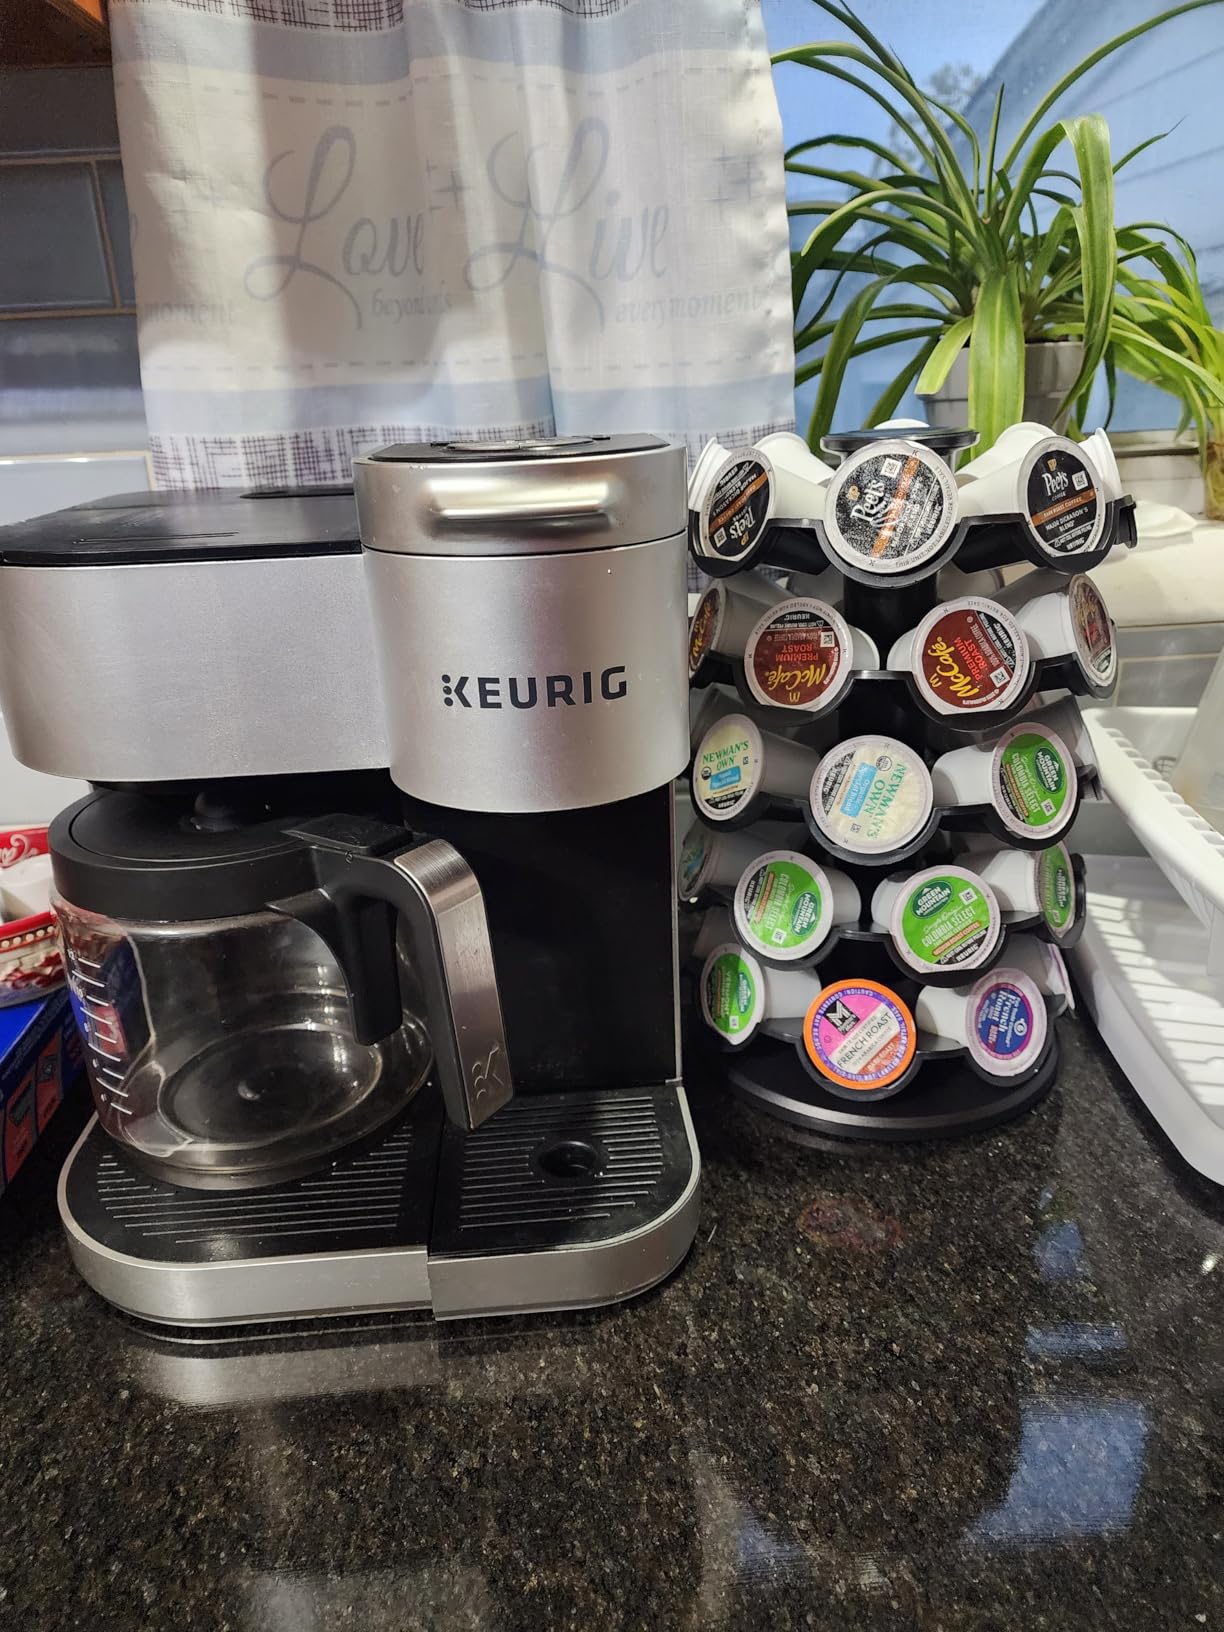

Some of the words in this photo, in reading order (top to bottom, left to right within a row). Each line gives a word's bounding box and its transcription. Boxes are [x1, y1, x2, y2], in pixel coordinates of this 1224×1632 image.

[244, 126, 425, 330] Love
[849, 478, 885, 522] Peet's
[1040, 471, 1070, 496] Peet's
[781, 643, 812, 652] ROAST
[992, 620, 1013, 649] KEURIG
[775, 652, 818, 661] PREMIUM
[927, 639, 980, 699] McCafé
[952, 635, 983, 681] PREMIUM
[963, 636, 988, 670] ROAST
[442, 666, 628, 709] KEURIG
[767, 663, 826, 690] McCafé
[700, 740, 750, 764] NEWMAN'S
[715, 755, 737, 771] OWN
[1043, 753, 1059, 782] GREEN
[1035, 750, 1057, 791] MOUNTAIN
[862, 777, 887, 815] OWN
[865, 762, 907, 840] NEWMAN'S
[1023, 787, 1041, 814] SELECT
[915, 885, 942, 906] GREEN
[915, 886, 951, 916] MOUNTAIN
[793, 892, 811, 933] MOUNTAIN
[801, 900, 814, 928] GREEN
[920, 919, 953, 948] COLOMBIA
[950, 904, 977, 927] SELECT
[990, 989, 1007, 1022] Roast
[997, 993, 1016, 1033] French
[835, 1035, 869, 1068] FRENCH
[864, 1011, 893, 1040] ROAST
